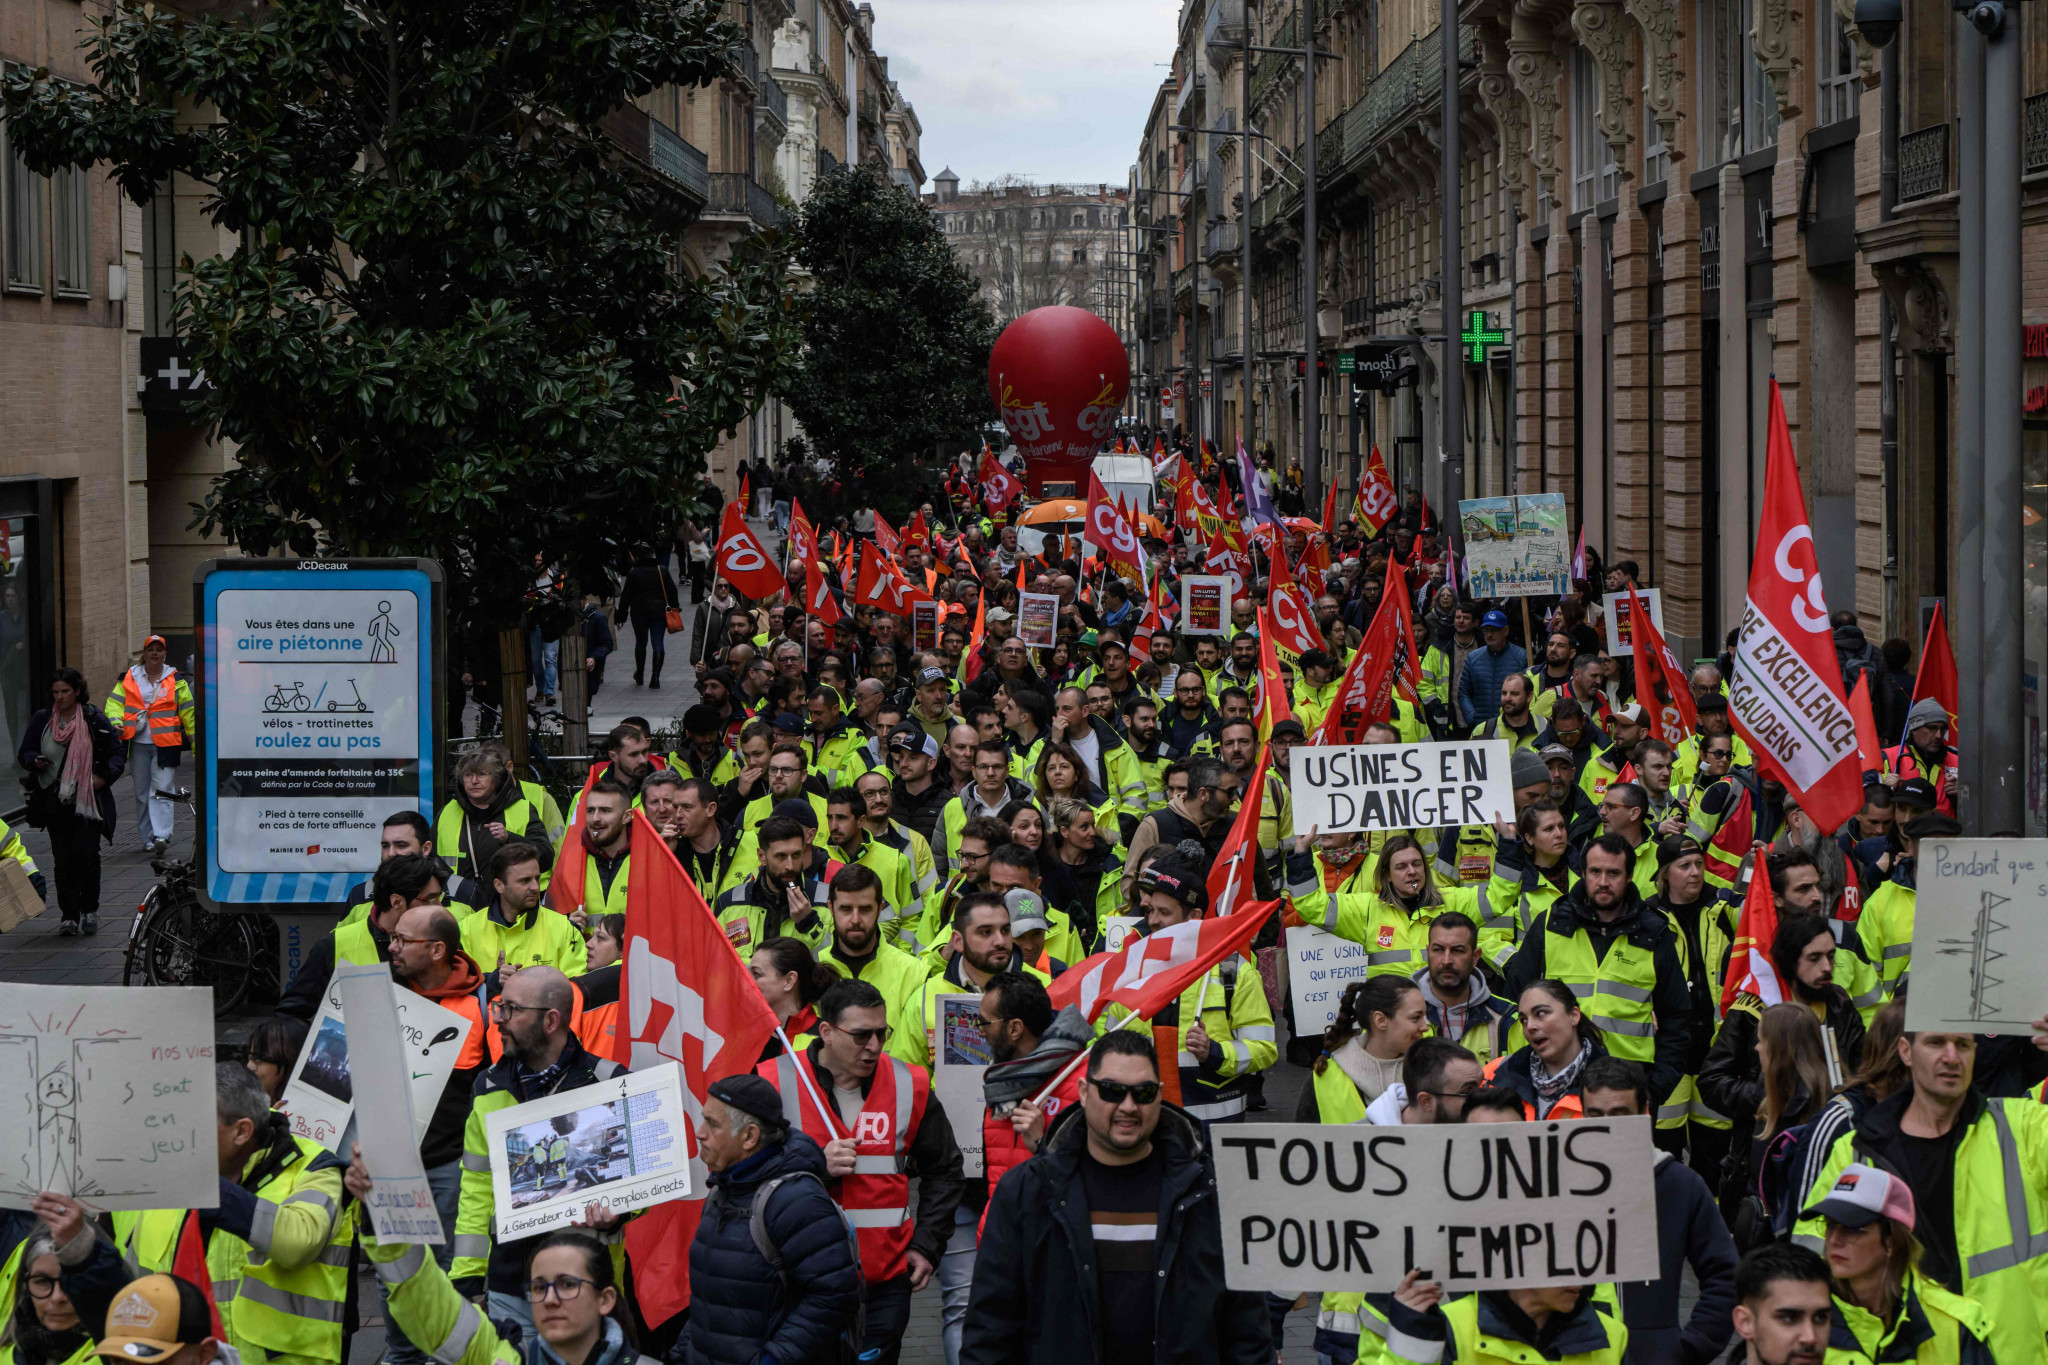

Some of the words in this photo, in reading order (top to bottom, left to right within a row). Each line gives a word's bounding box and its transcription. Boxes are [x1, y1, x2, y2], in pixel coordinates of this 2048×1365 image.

[1357, 354, 1397, 370] modi
[1002, 401, 1055, 440] cgt
[722, 533, 766, 572] FO
[297, 561, 348, 571] JCDecaux
[245, 619, 273, 629] Vous
[275, 618, 300, 629] êtes
[302, 619, 331, 629] dans
[333, 621, 355, 629] une
[237, 635, 273, 651] aire
[280, 635, 363, 654] piétonne
[1752, 636, 1857, 755] EXCELLENCE
[263, 718, 293, 729] vélos
[306, 719, 374, 729] trottinettes
[1730, 670, 1802, 764] T-GAUDENS
[255, 732, 312, 748] roulez
[317, 736, 341, 748] au
[347, 736, 381, 751] pas
[232, 769, 253, 777] sous
[254, 768, 280, 778] peine
[281, 768, 326, 777] d'amende
[327, 768, 372, 777] forfaitaire
[374, 768, 386, 777] de
[387, 769, 404, 777] 35€
[1305, 747, 1422, 788] USINES
[1440, 748, 1488, 782] EN
[261, 780, 286, 789] définie
[288, 782, 301, 790] par
[303, 780, 310, 788] le
[312, 780, 334, 789] Code
[335, 780, 345, 789] de
[347, 780, 354, 788] la
[1594, 783, 1606, 793] cgt
[265, 810, 286, 819] Pied
[289, 810, 296, 818] à
[298, 811, 321, 819] terre
[323, 810, 364, 819] conseillé
[1327, 785, 1486, 829] DANGER
[259, 822, 271, 830] en
[273, 822, 290, 830] cas
[292, 820, 305, 829] de
[307, 820, 330, 829] forte
[332, 820, 377, 830] affluence
[1933, 845, 2000, 878] Pendant
[2008, 861, 2035, 885] que
[1844, 886, 1859, 909] FO
[1378, 934, 1393, 945] cgt
[1300, 948, 1324, 962] UNE
[1310, 968, 1326, 981] QUI
[1330, 964, 1368, 979] FERME
[1304, 991, 1329, 1002] C'EST
[152, 1045, 181, 1061] nos
[185, 1046, 214, 1059] vies
[153, 1077, 193, 1098] sont
[144, 1113, 176, 1128] en
[295, 1115, 312, 1135] Pas
[314, 1127, 325, 1142] là
[856, 1111, 890, 1140] FO
[1221, 1135, 1408, 1197] TOUS
[1443, 1123, 1612, 1202] UNIS
[512, 1211, 563, 1232] Générateur
[565, 1206, 578, 1218] de
[612, 1189, 649, 1209] emplois
[651, 1177, 685, 1196] directs
[1240, 1214, 1380, 1275] POUR
[1403, 1207, 1617, 1280] L'EMPLOI
